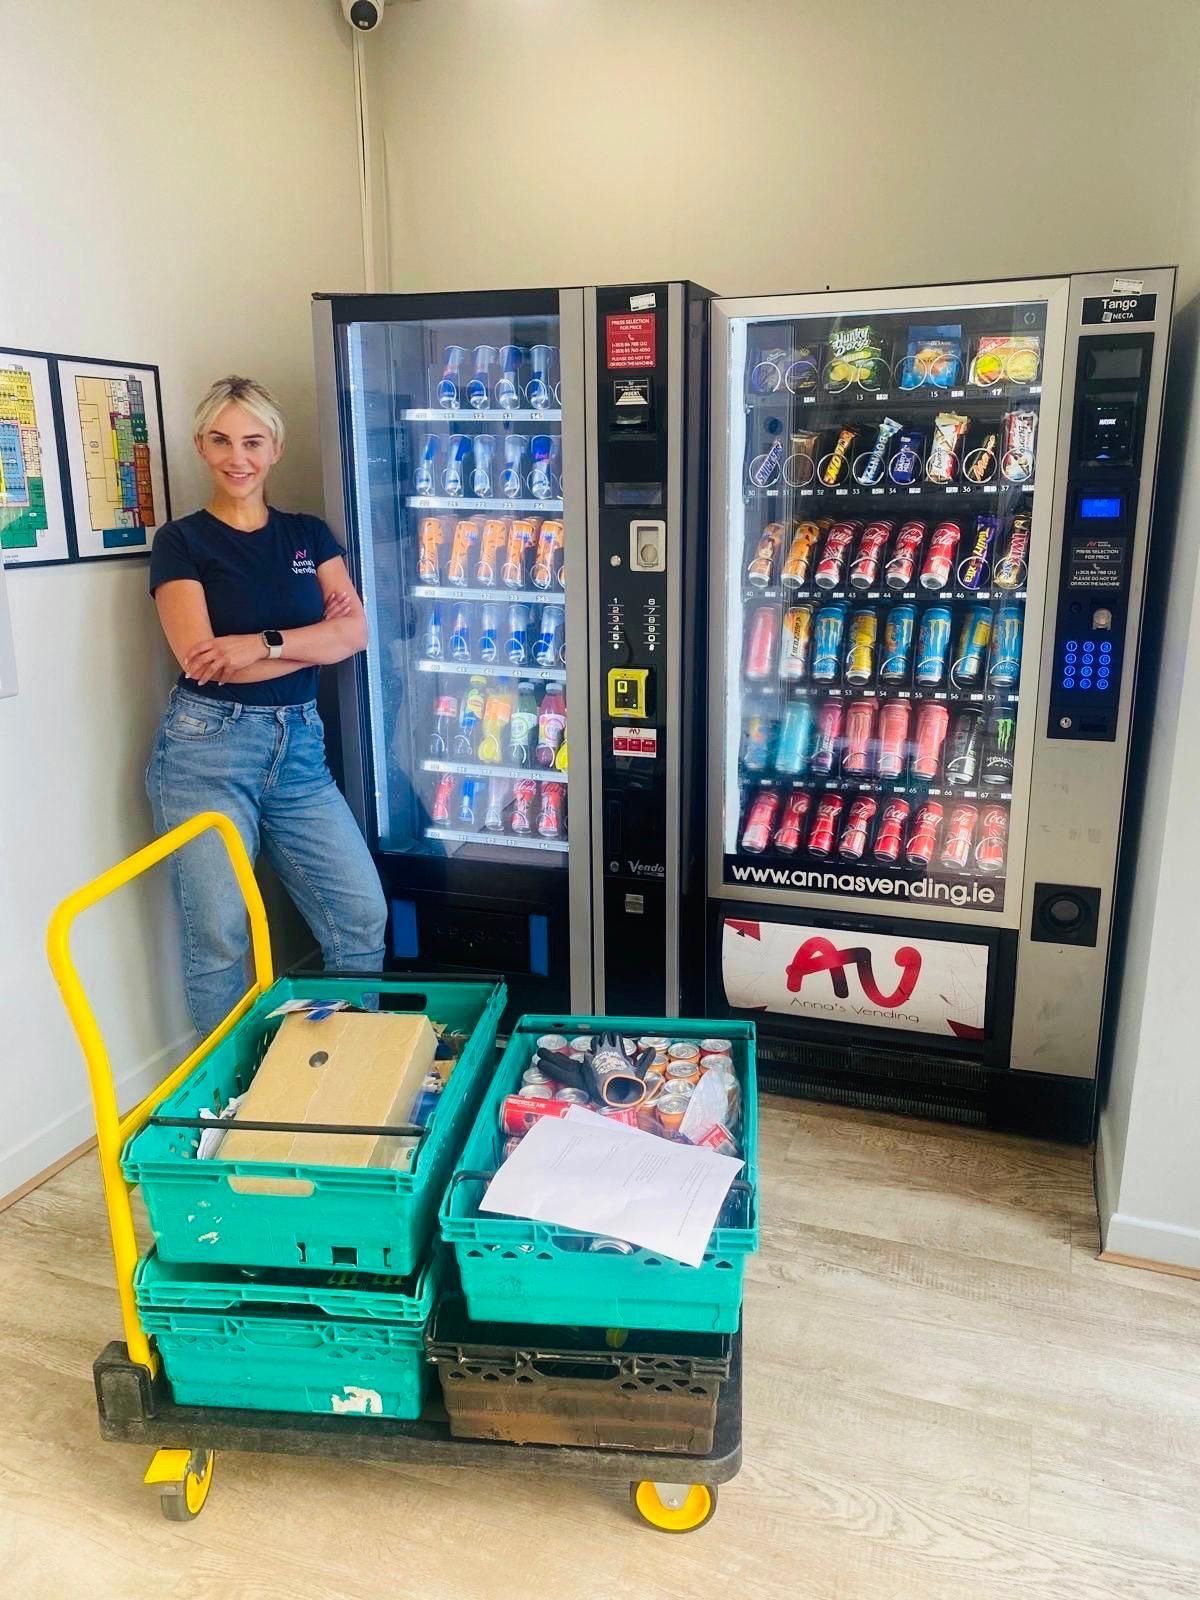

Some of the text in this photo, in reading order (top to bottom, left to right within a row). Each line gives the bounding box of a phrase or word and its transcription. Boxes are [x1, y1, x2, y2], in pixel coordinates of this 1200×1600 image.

[1101, 298, 1138, 311] Tango
[1112, 312, 1134, 320] NECTA
[756, 443, 782, 483] SNICKERS
[882, 805, 906, 821] Coca
[984, 810, 1006, 827] Coca
[627, 860, 665, 873] Vendo
[732, 865, 996, 905] www.annasvending.ie
[790, 997, 920, 1024] Anna's Vending
